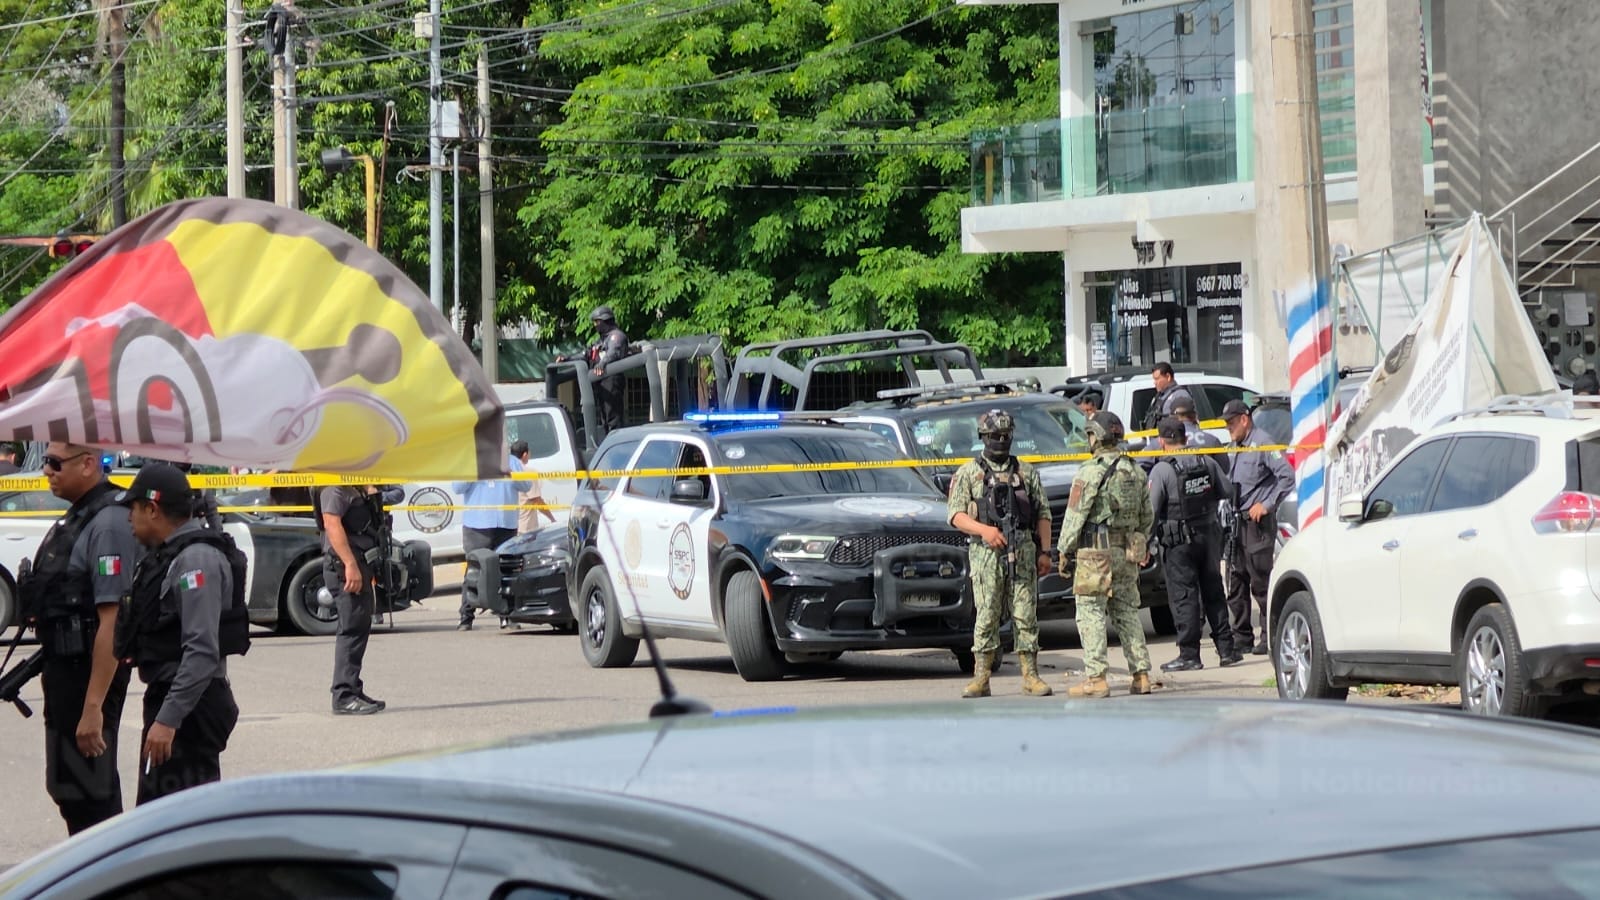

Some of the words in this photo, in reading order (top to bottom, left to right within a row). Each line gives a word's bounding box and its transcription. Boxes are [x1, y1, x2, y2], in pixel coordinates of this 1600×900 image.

[1201, 275, 1216, 292] 667
[1217, 274, 1232, 291] 780
[205, 476, 247, 487] CAUTION
[273, 474, 314, 485] CAUTION
[1185, 475, 1209, 489] SSPC
